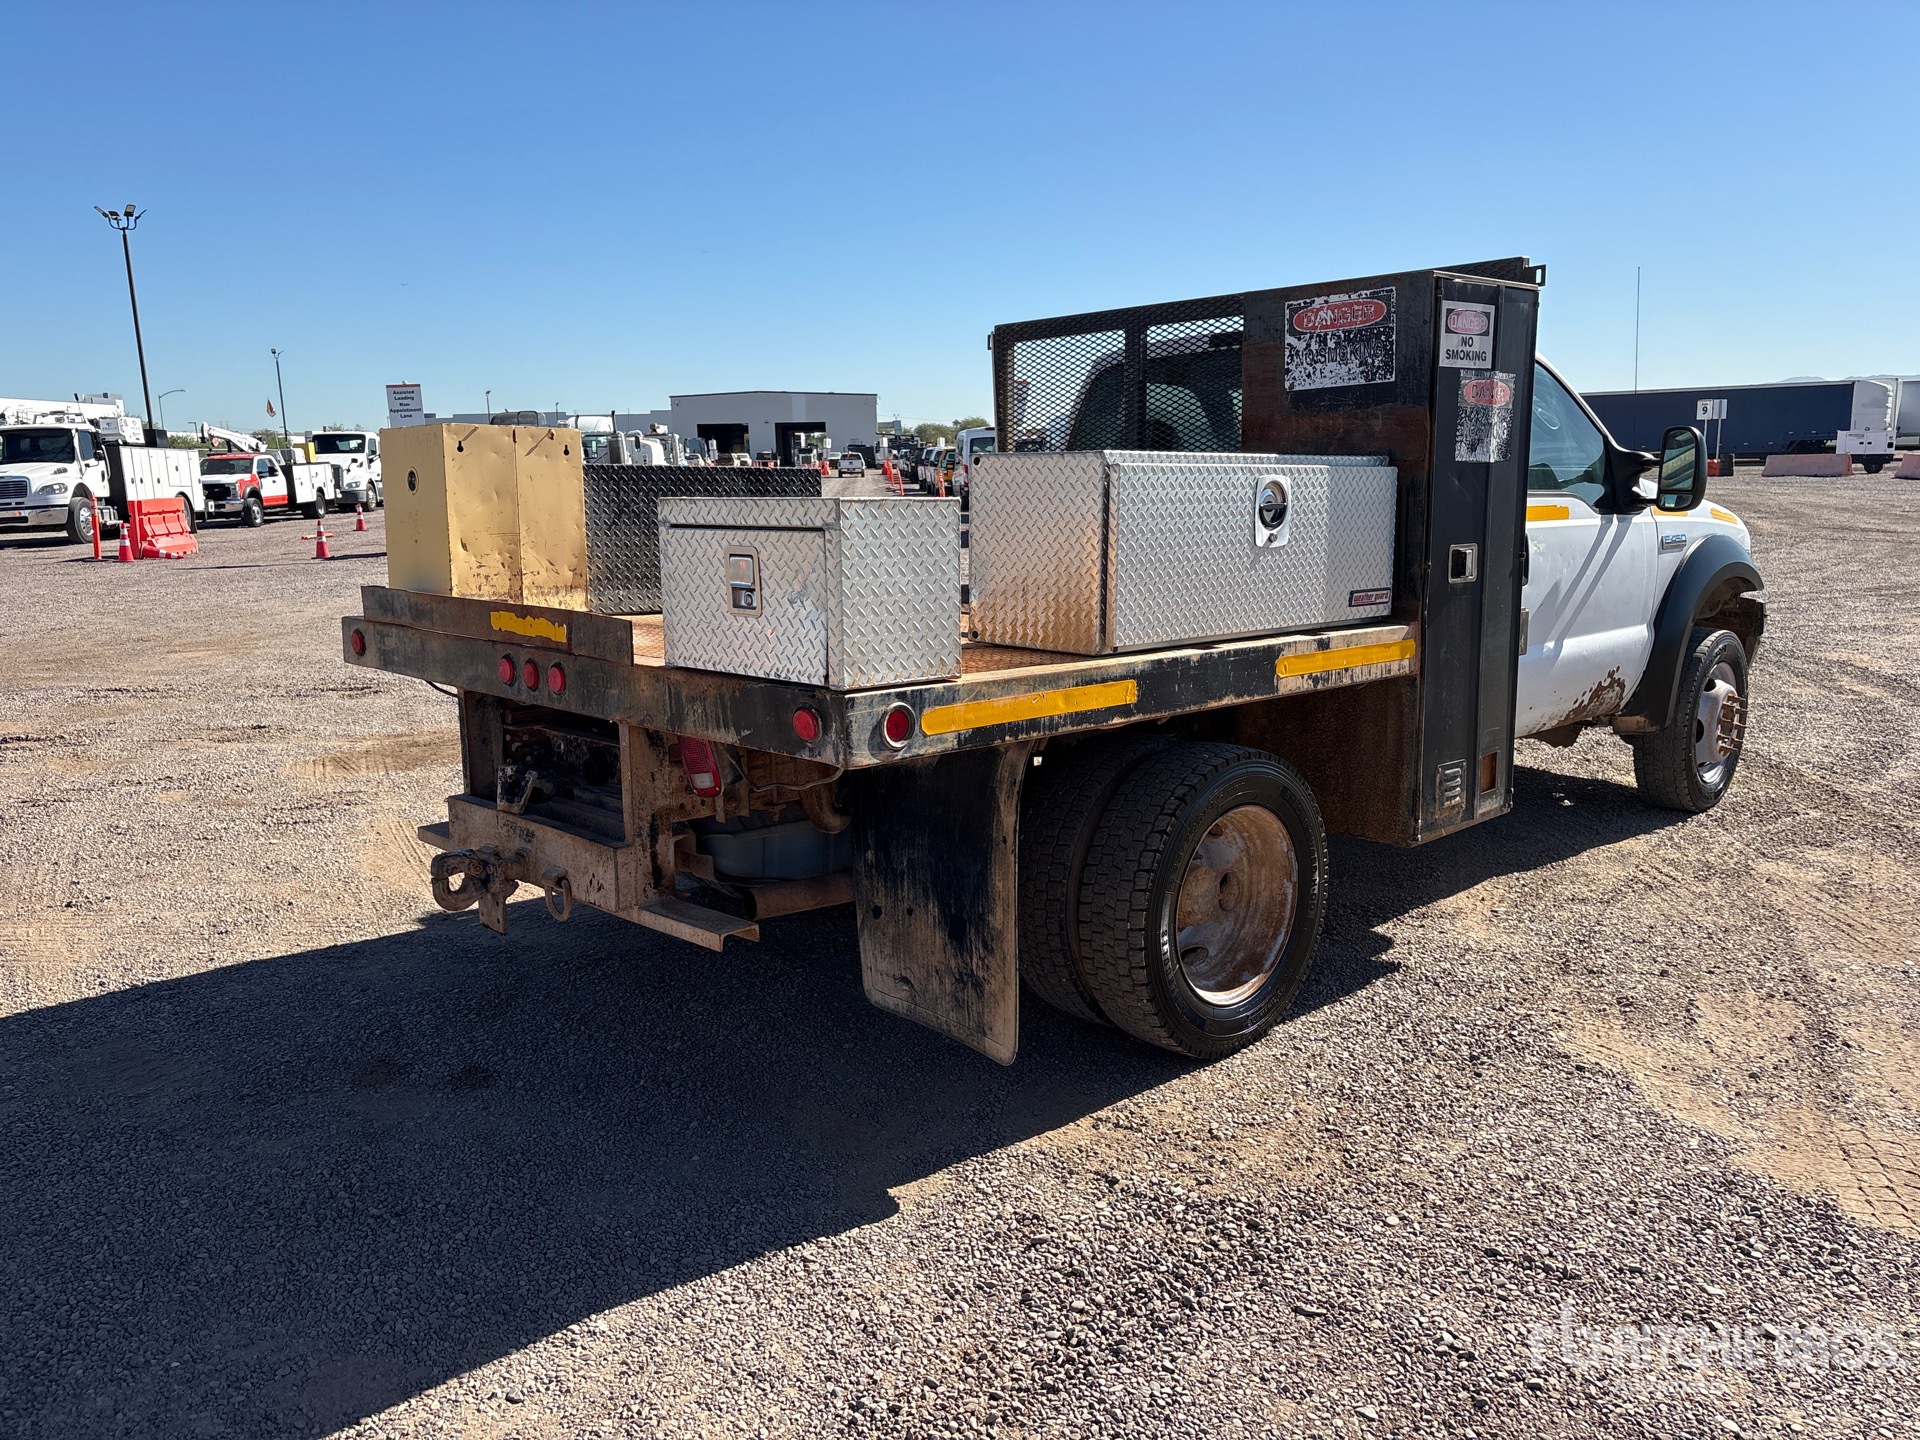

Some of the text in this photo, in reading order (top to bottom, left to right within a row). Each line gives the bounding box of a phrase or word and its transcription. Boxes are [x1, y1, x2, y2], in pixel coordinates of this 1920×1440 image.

[1303, 304, 1375, 328] DANGER
[1450, 314, 1487, 330] DANGER
[1460, 336, 1474, 348] NO
[1445, 348, 1487, 362] SMOKING
[1702, 406, 1708, 415] 9
